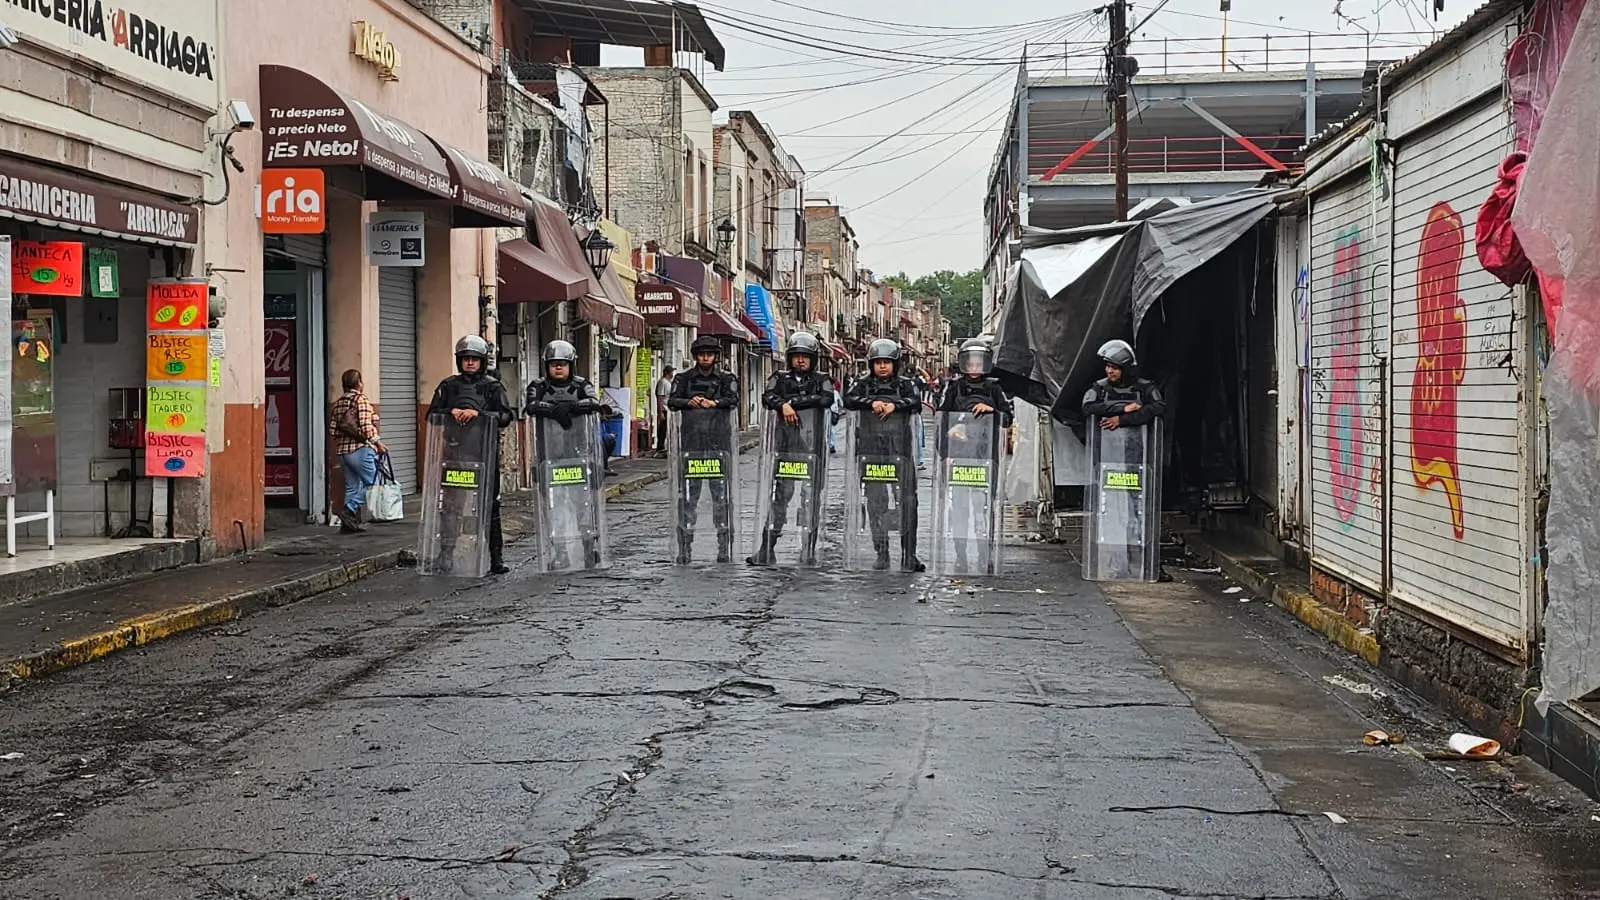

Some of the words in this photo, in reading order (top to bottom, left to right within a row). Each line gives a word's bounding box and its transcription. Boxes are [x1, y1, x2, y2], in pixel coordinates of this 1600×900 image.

[269, 108, 285, 118] Tu
[286, 107, 345, 119] despensa
[268, 126, 276, 135] a
[277, 123, 315, 137] precio
[317, 123, 347, 134] Neto
[267, 141, 298, 162] ¡Es
[303, 139, 359, 158] Neto!
[371, 150, 396, 173] despensa
[267, 176, 321, 214] ria
[267, 215, 291, 224] Money
[292, 215, 320, 223] Transfer
[11, 241, 72, 262] MANTECA
[151, 285, 200, 299] MOLIDA
[149, 335, 193, 348] BISTEC
[164, 348, 192, 361] RES
[149, 386, 193, 401] BISTEC
[152, 403, 193, 414] TAQUERO
[147, 431, 191, 448] BISTEC
[157, 449, 194, 458] LIMPIO
[553, 467, 582, 475] POLICIA
[953, 466, 985, 475] POLICIA
